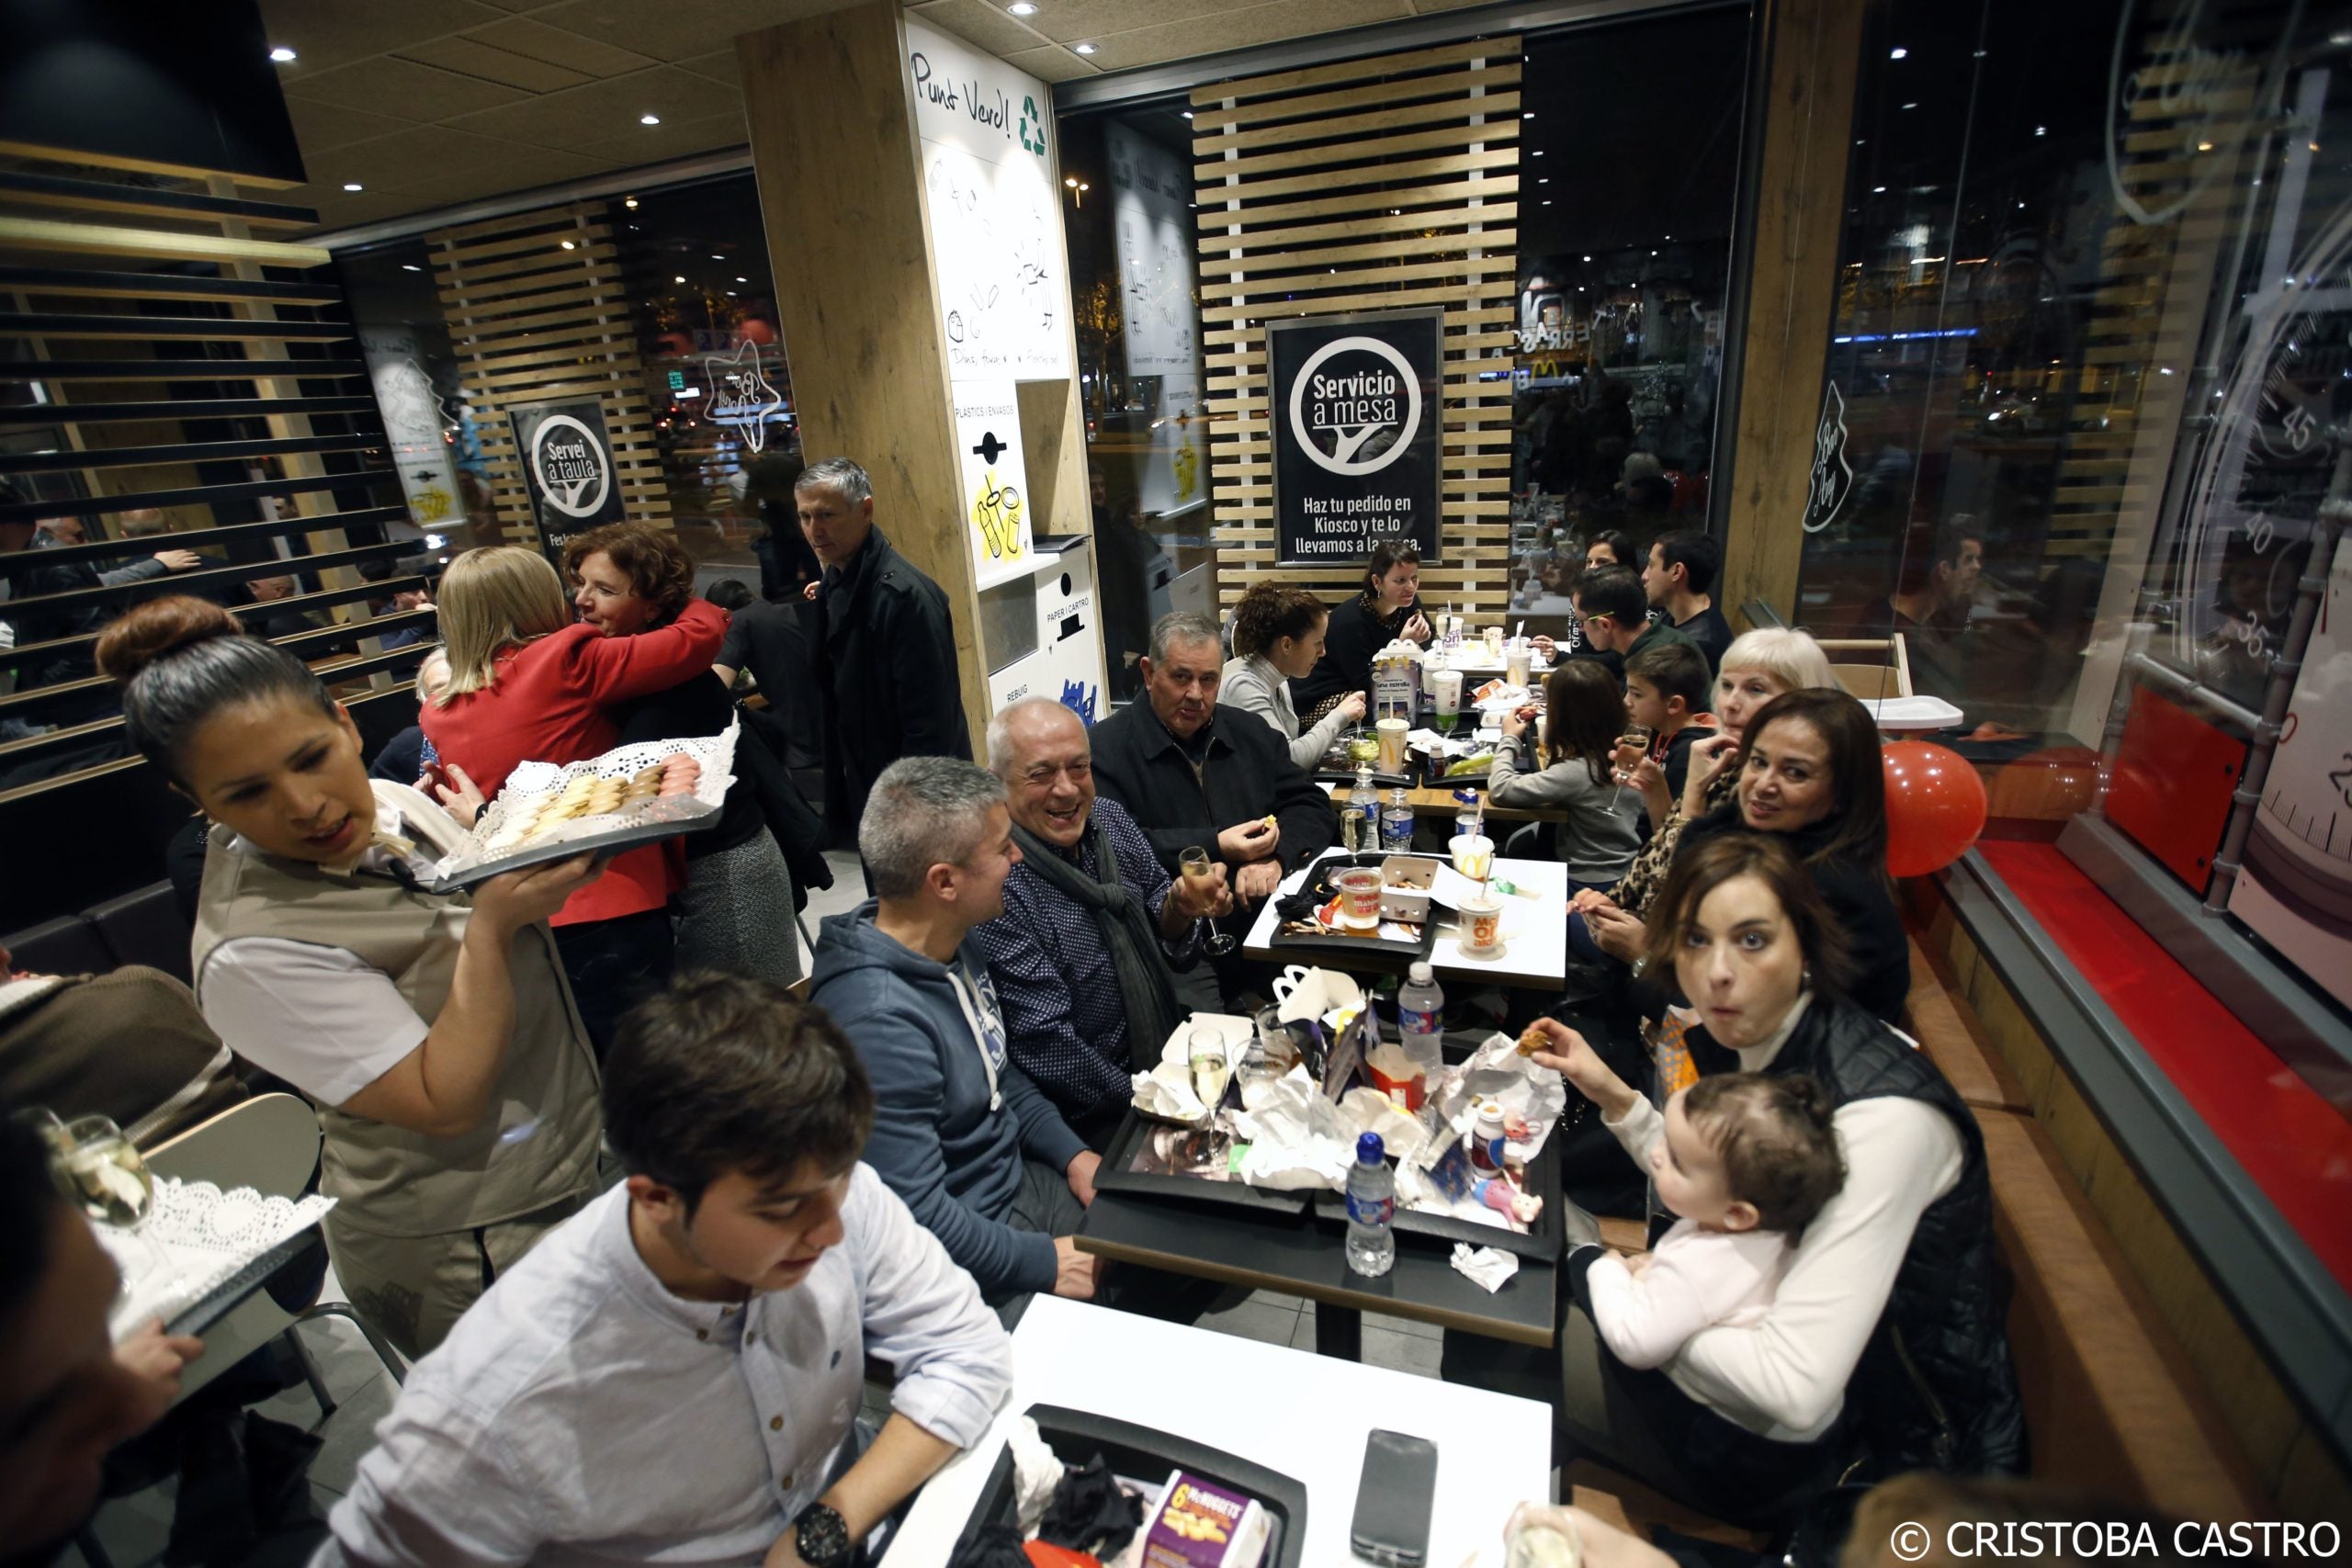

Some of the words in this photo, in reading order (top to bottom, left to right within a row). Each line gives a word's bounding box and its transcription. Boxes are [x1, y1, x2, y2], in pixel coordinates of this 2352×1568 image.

[910, 51, 958, 110] Punt
[963, 80, 1011, 139] Verd!
[1313, 370, 1396, 400] Servicio
[1314, 402, 1326, 425] a
[1334, 398, 1396, 423] mesa
[547, 439, 586, 461] Servei
[548, 462, 558, 481] a
[559, 459, 595, 479] taula
[1304, 497, 1328, 514] Haz
[1330, 498, 1344, 513] tu
[1347, 495, 1391, 515] pedido
[1395, 497, 1411, 512] en
[1315, 516, 1358, 534] Kiosco
[1361, 519, 1368, 536] y
[1372, 518, 1385, 533] te
[1387, 515, 1400, 532] lo
[549, 534, 563, 547] Fes
[1295, 536, 1353, 554] llevamos
[1356, 540, 1364, 552] a
[1367, 536, 1379, 552] la
[1047, 607, 1065, 623] PAPER
[1007, 683, 1028, 704] REBUIG
[1171, 1483, 1191, 1508] 6
